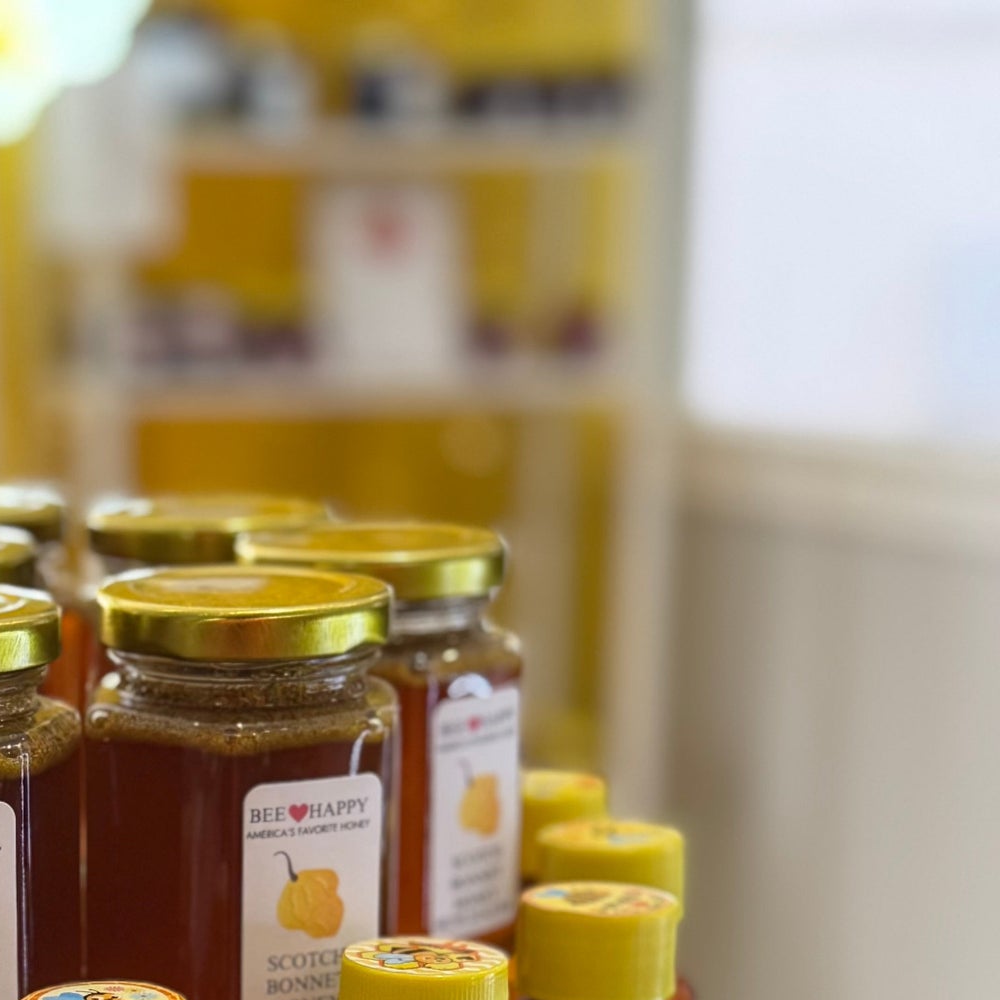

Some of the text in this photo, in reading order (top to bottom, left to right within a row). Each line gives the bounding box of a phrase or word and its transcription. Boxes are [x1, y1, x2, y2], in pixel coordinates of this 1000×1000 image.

[250, 797, 368, 824] BEE HAPPY
[246, 819, 370, 840] AMERICA'S FAVORITE HONEY
